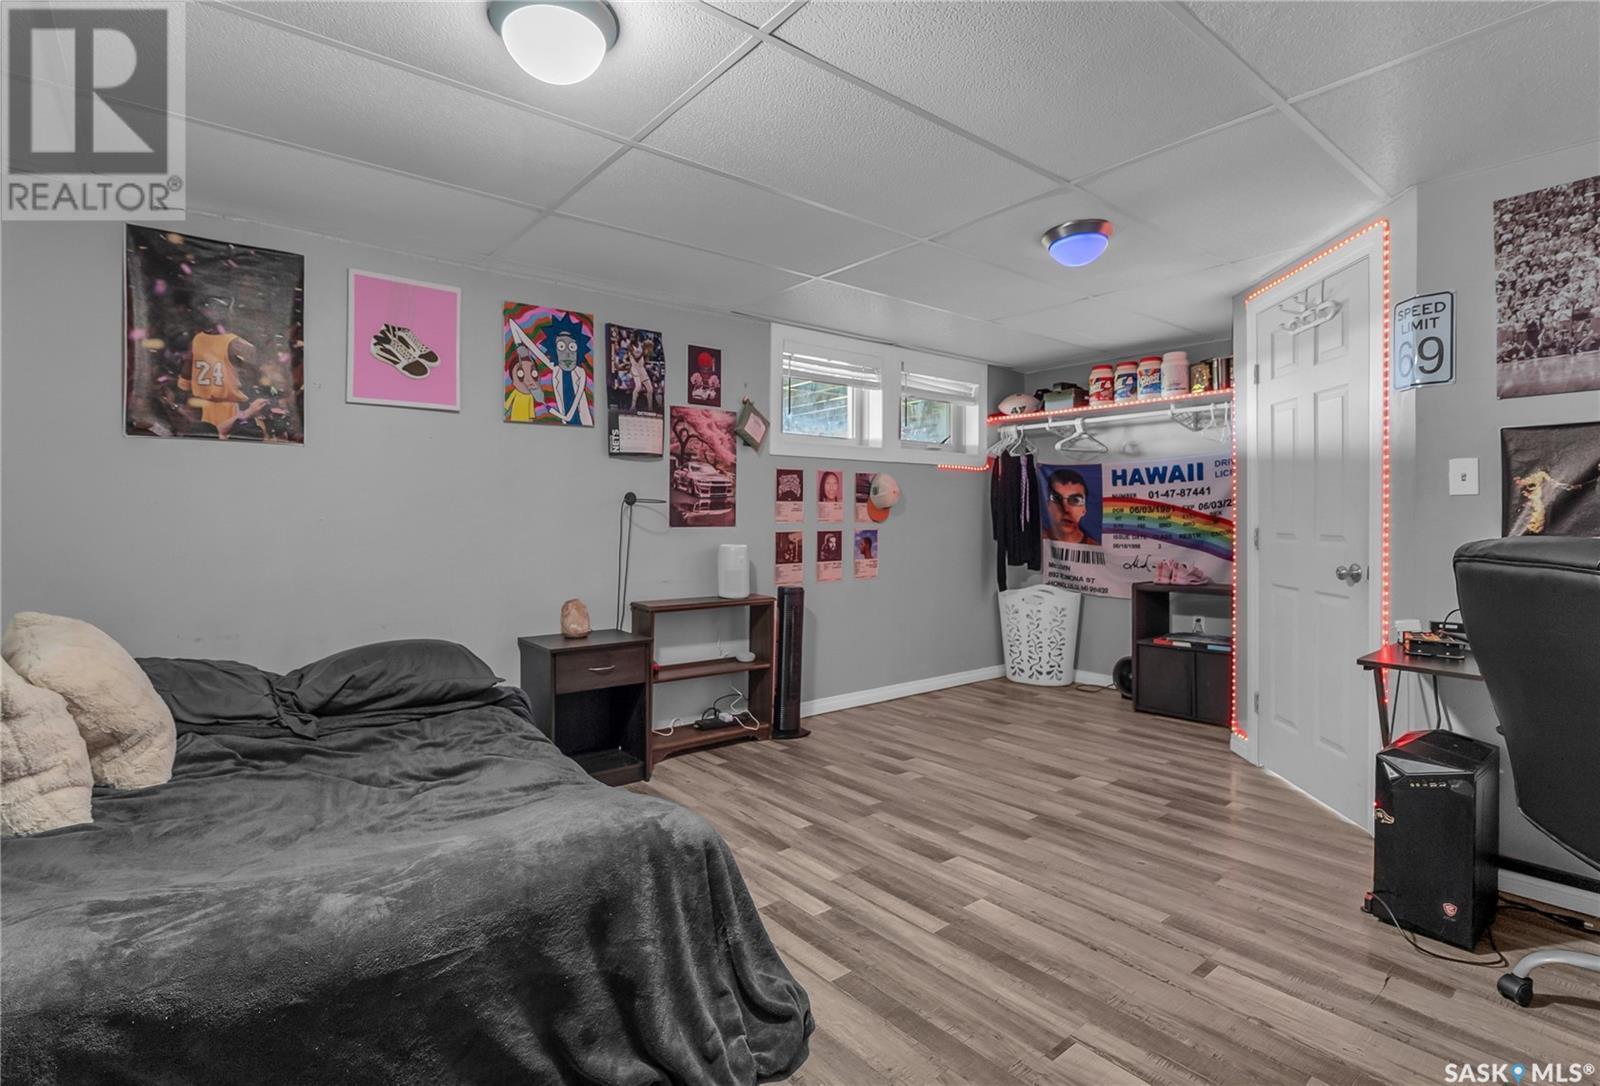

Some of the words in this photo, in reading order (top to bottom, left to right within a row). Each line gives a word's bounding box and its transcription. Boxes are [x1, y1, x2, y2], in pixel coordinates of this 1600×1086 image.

[1398, 301, 1447, 322] SPEED
[1401, 316, 1440, 335] LIMIT
[1399, 336, 1444, 378] 69
[195, 360, 225, 387] 24
[611, 429, 620, 453] NETS
[1111, 462, 1204, 487] HAWAII
[1147, 486, 1211, 499] 01-47-87441
